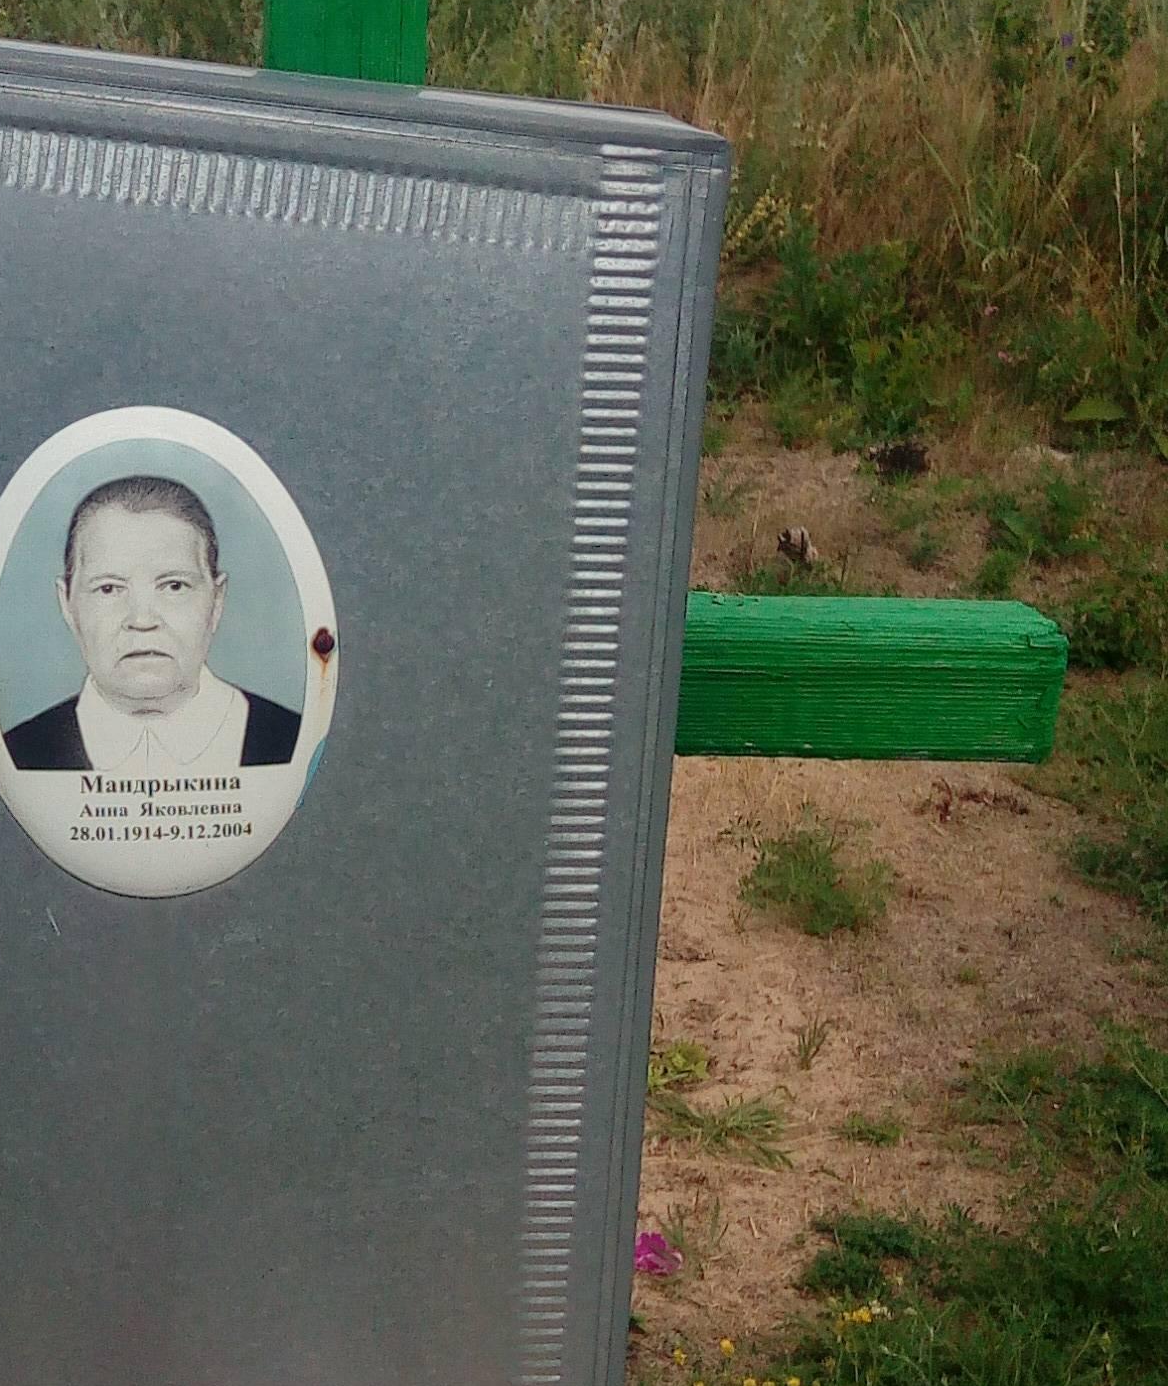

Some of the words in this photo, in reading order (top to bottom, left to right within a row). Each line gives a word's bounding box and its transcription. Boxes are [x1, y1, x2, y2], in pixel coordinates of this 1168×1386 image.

[81, 775, 241, 796] Мандрыкина
[80, 803, 129, 818] Анна
[139, 801, 243, 817] Яковлевна
[70, 822, 253, 841] 28.01.1914-9.12.2004
